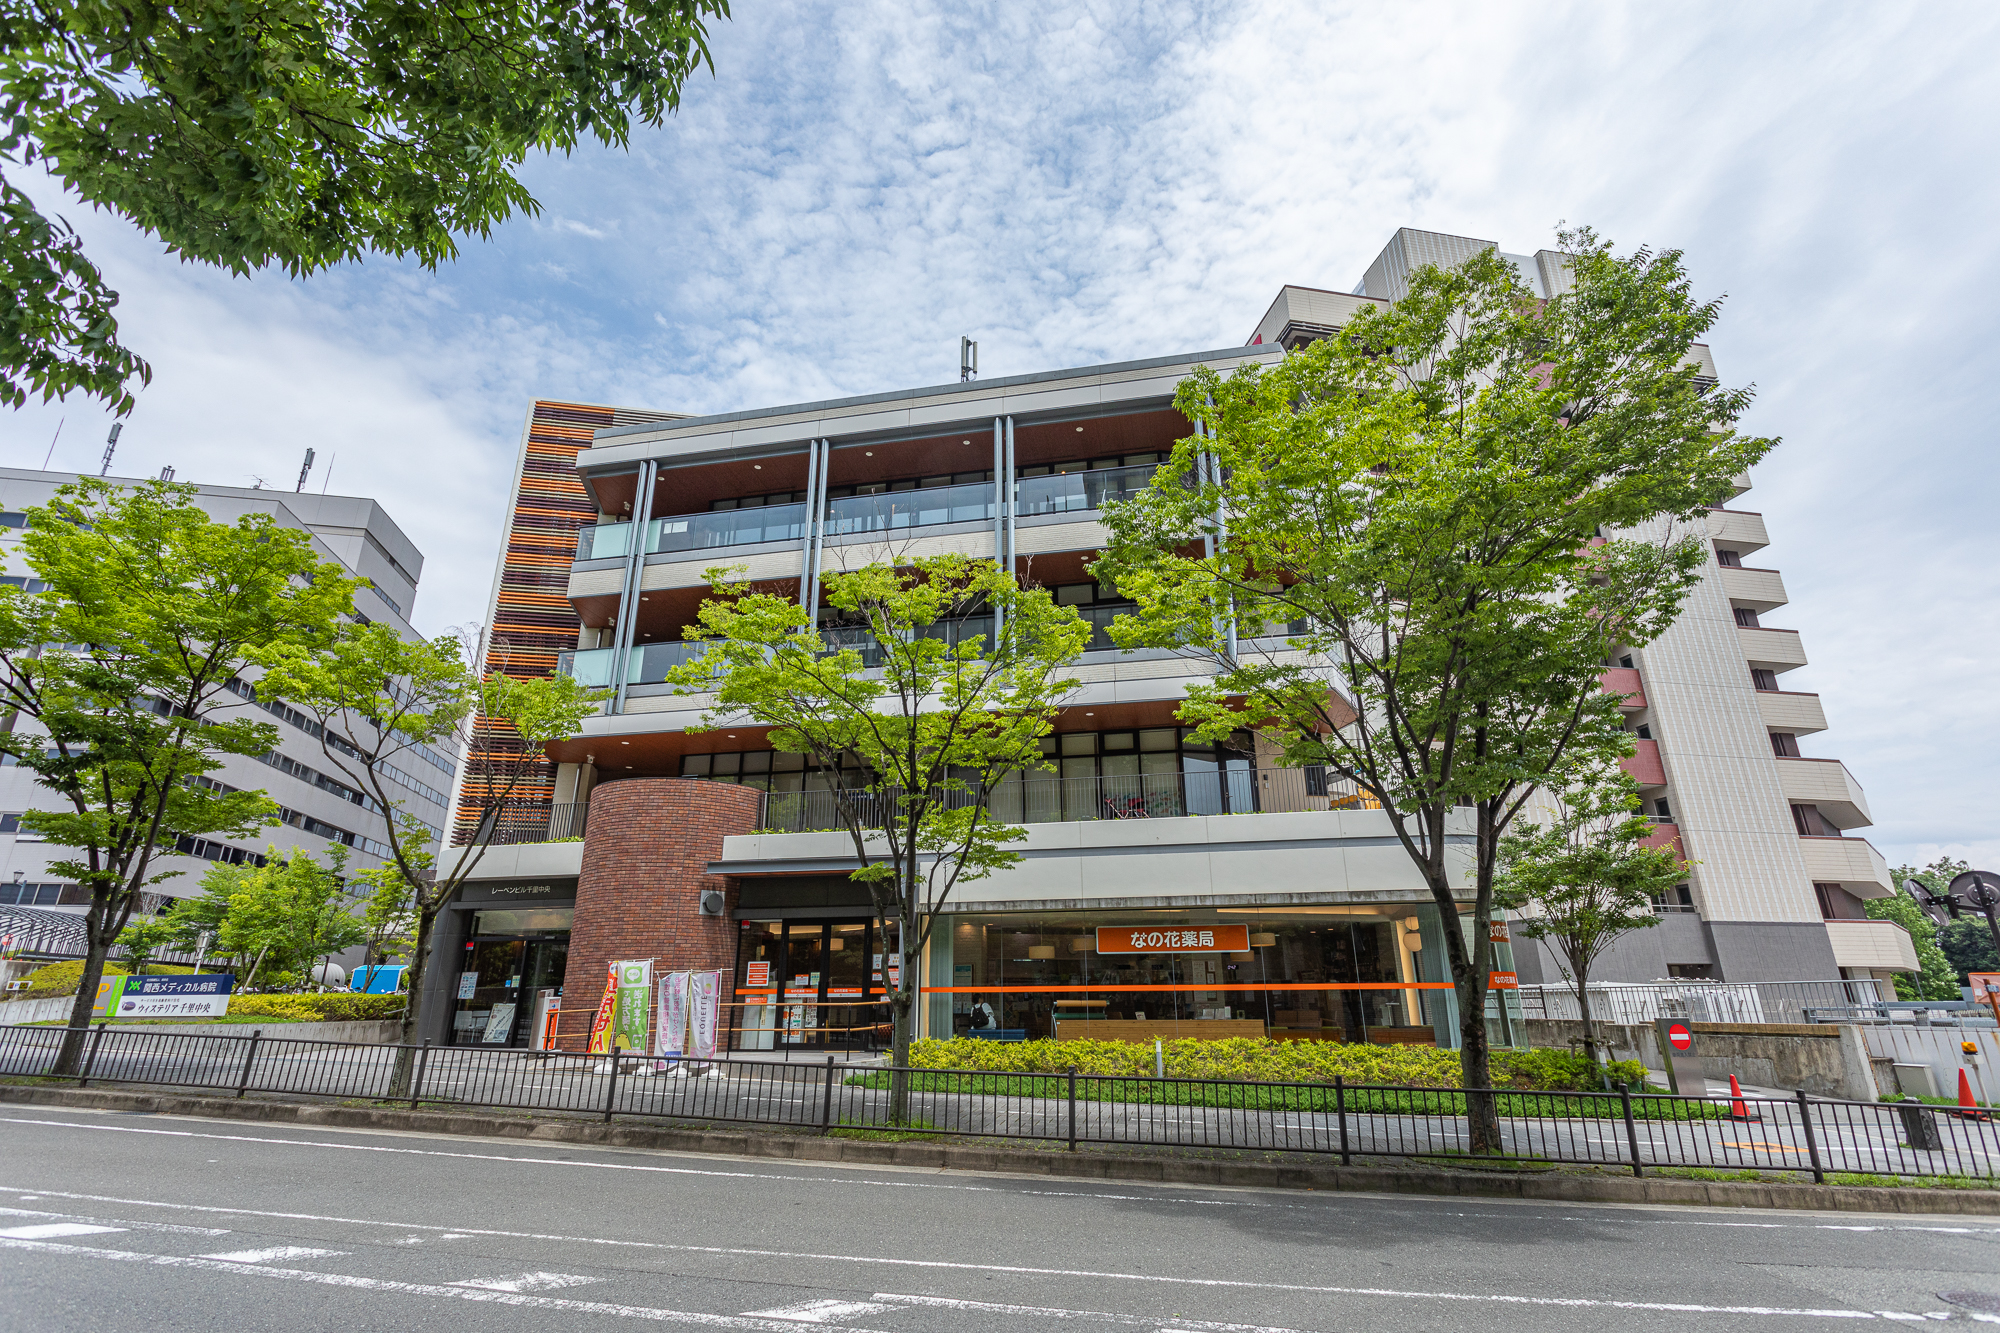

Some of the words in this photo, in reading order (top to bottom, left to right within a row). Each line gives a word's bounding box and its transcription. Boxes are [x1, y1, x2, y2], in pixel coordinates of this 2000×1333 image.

[491, 885, 551, 895] レーベンビル千里中央
[1130, 930, 1215, 948] なの花薬局
[95, 982, 111, 999] P
[142, 981, 218, 993] 関西メディカル病院
